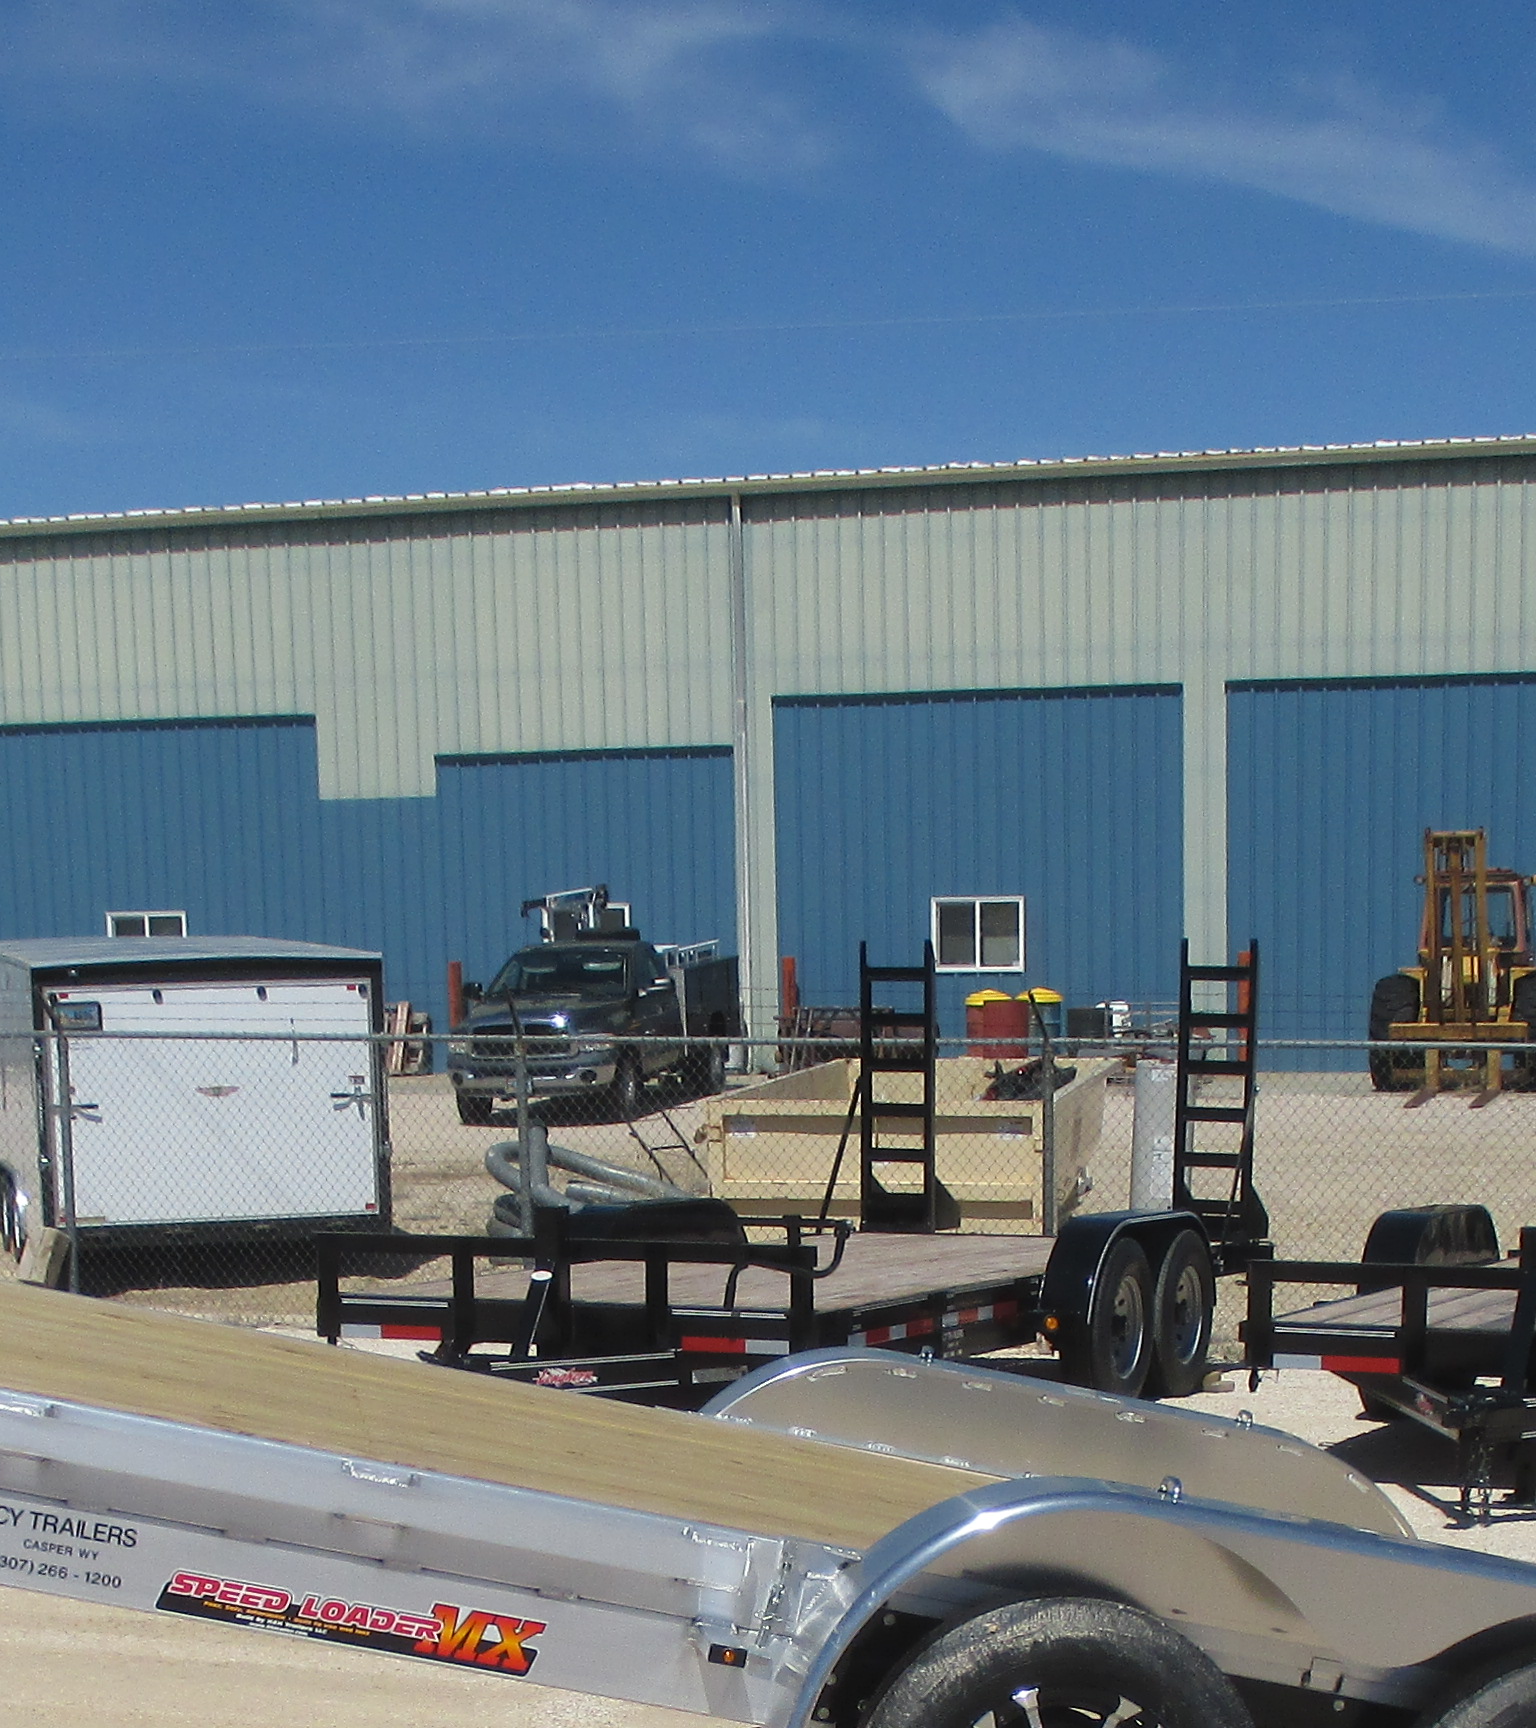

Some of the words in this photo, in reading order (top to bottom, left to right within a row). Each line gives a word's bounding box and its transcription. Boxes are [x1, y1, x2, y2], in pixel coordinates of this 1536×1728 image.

[30, 1511, 138, 1548] TRAILERS
[23, 1538, 74, 1557] CASPER
[78, 1548, 100, 1561] WY
[37, 1563, 69, 1580] 266
[84, 1571, 122, 1589] 1200
[168, 1572, 292, 1612] SPEED
[300, 1595, 444, 1642] LOADER
[413, 1602, 547, 1671] MX
